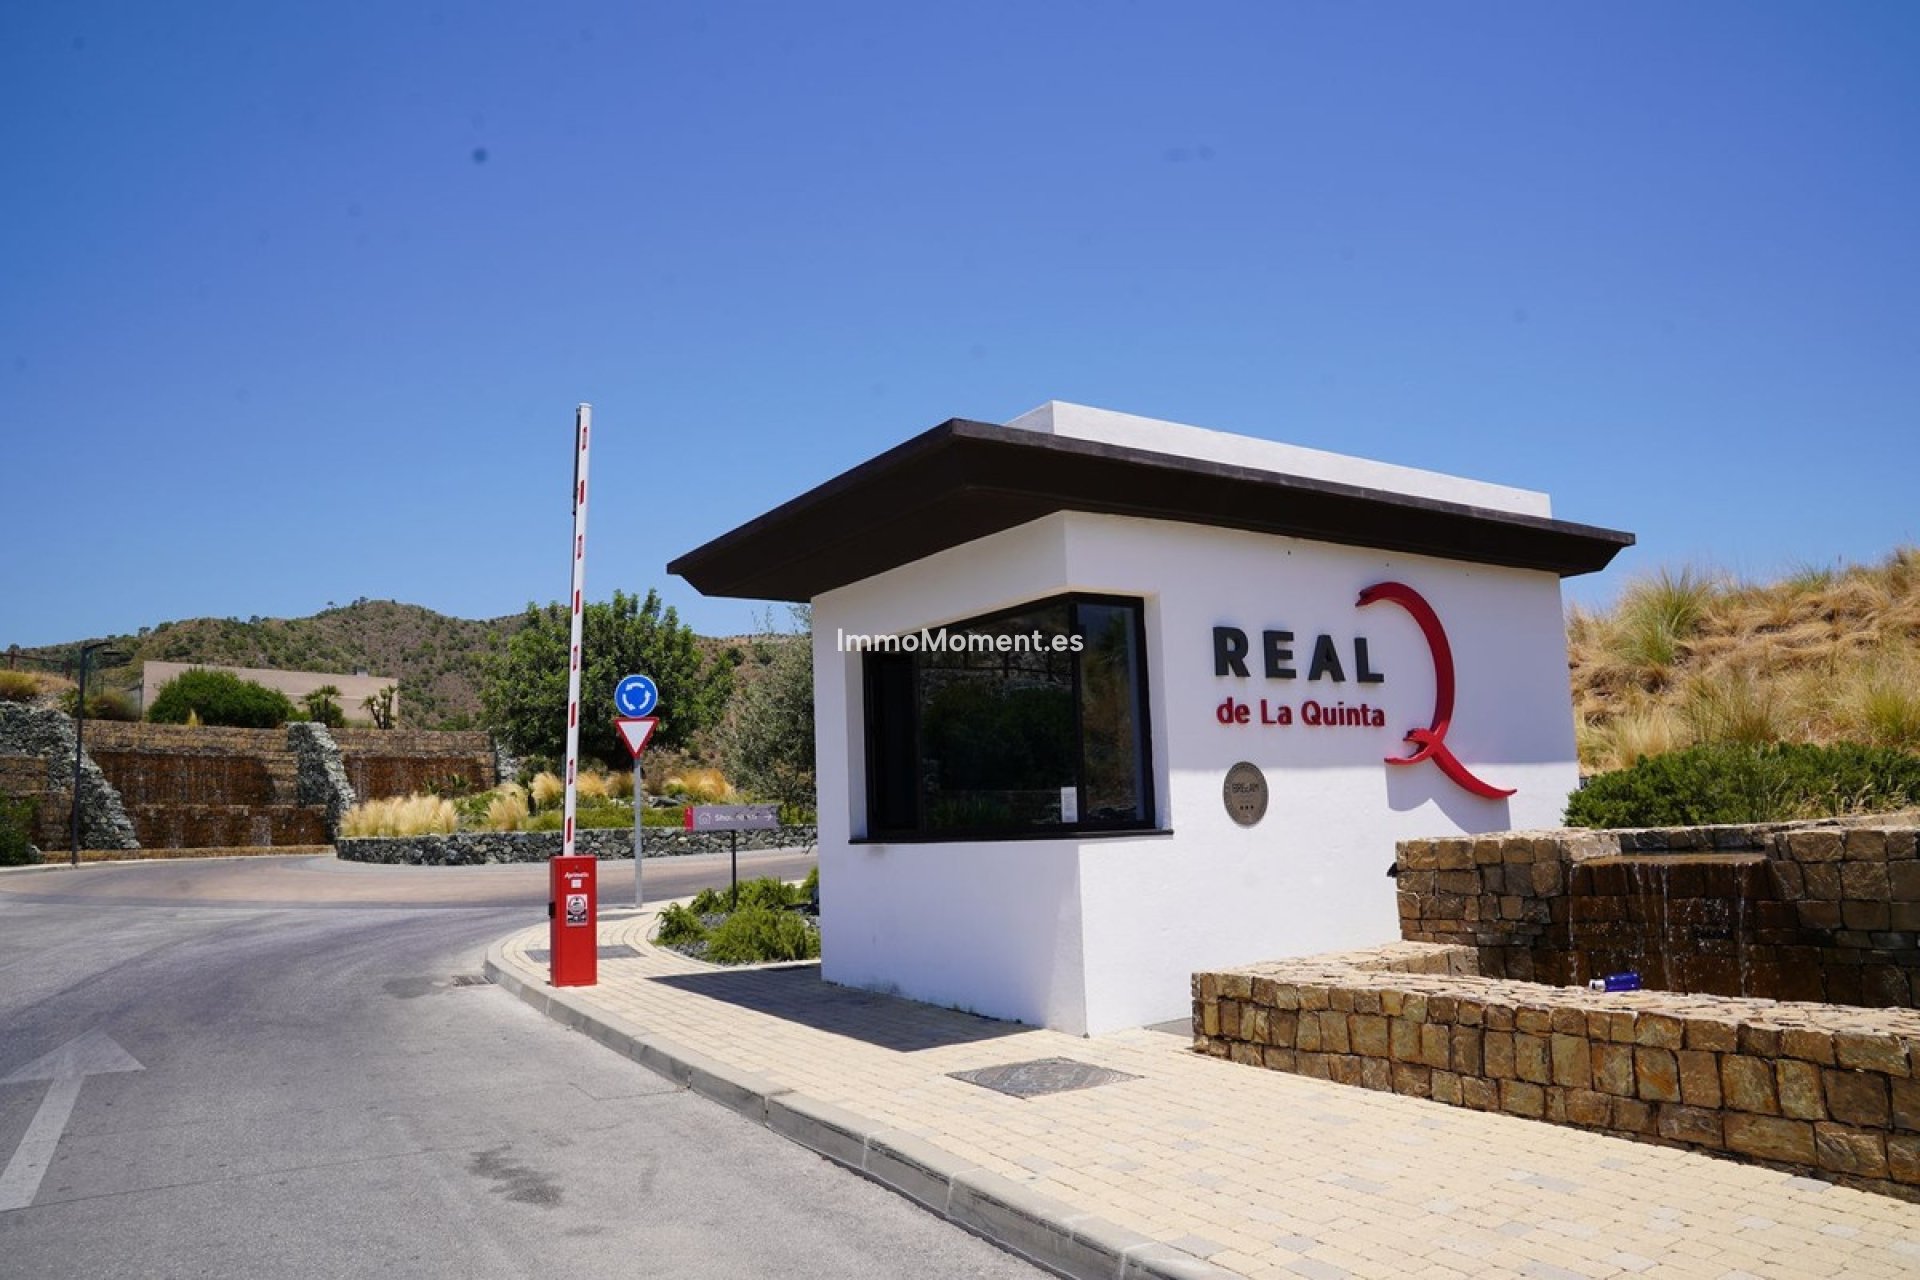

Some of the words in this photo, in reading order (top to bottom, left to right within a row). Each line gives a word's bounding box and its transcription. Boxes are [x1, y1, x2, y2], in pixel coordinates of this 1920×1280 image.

[1212, 625, 1385, 683] REAL
[1216, 697, 1250, 725] de
[1260, 699, 1293, 725] La
[1300, 700, 1386, 727] Quinta
